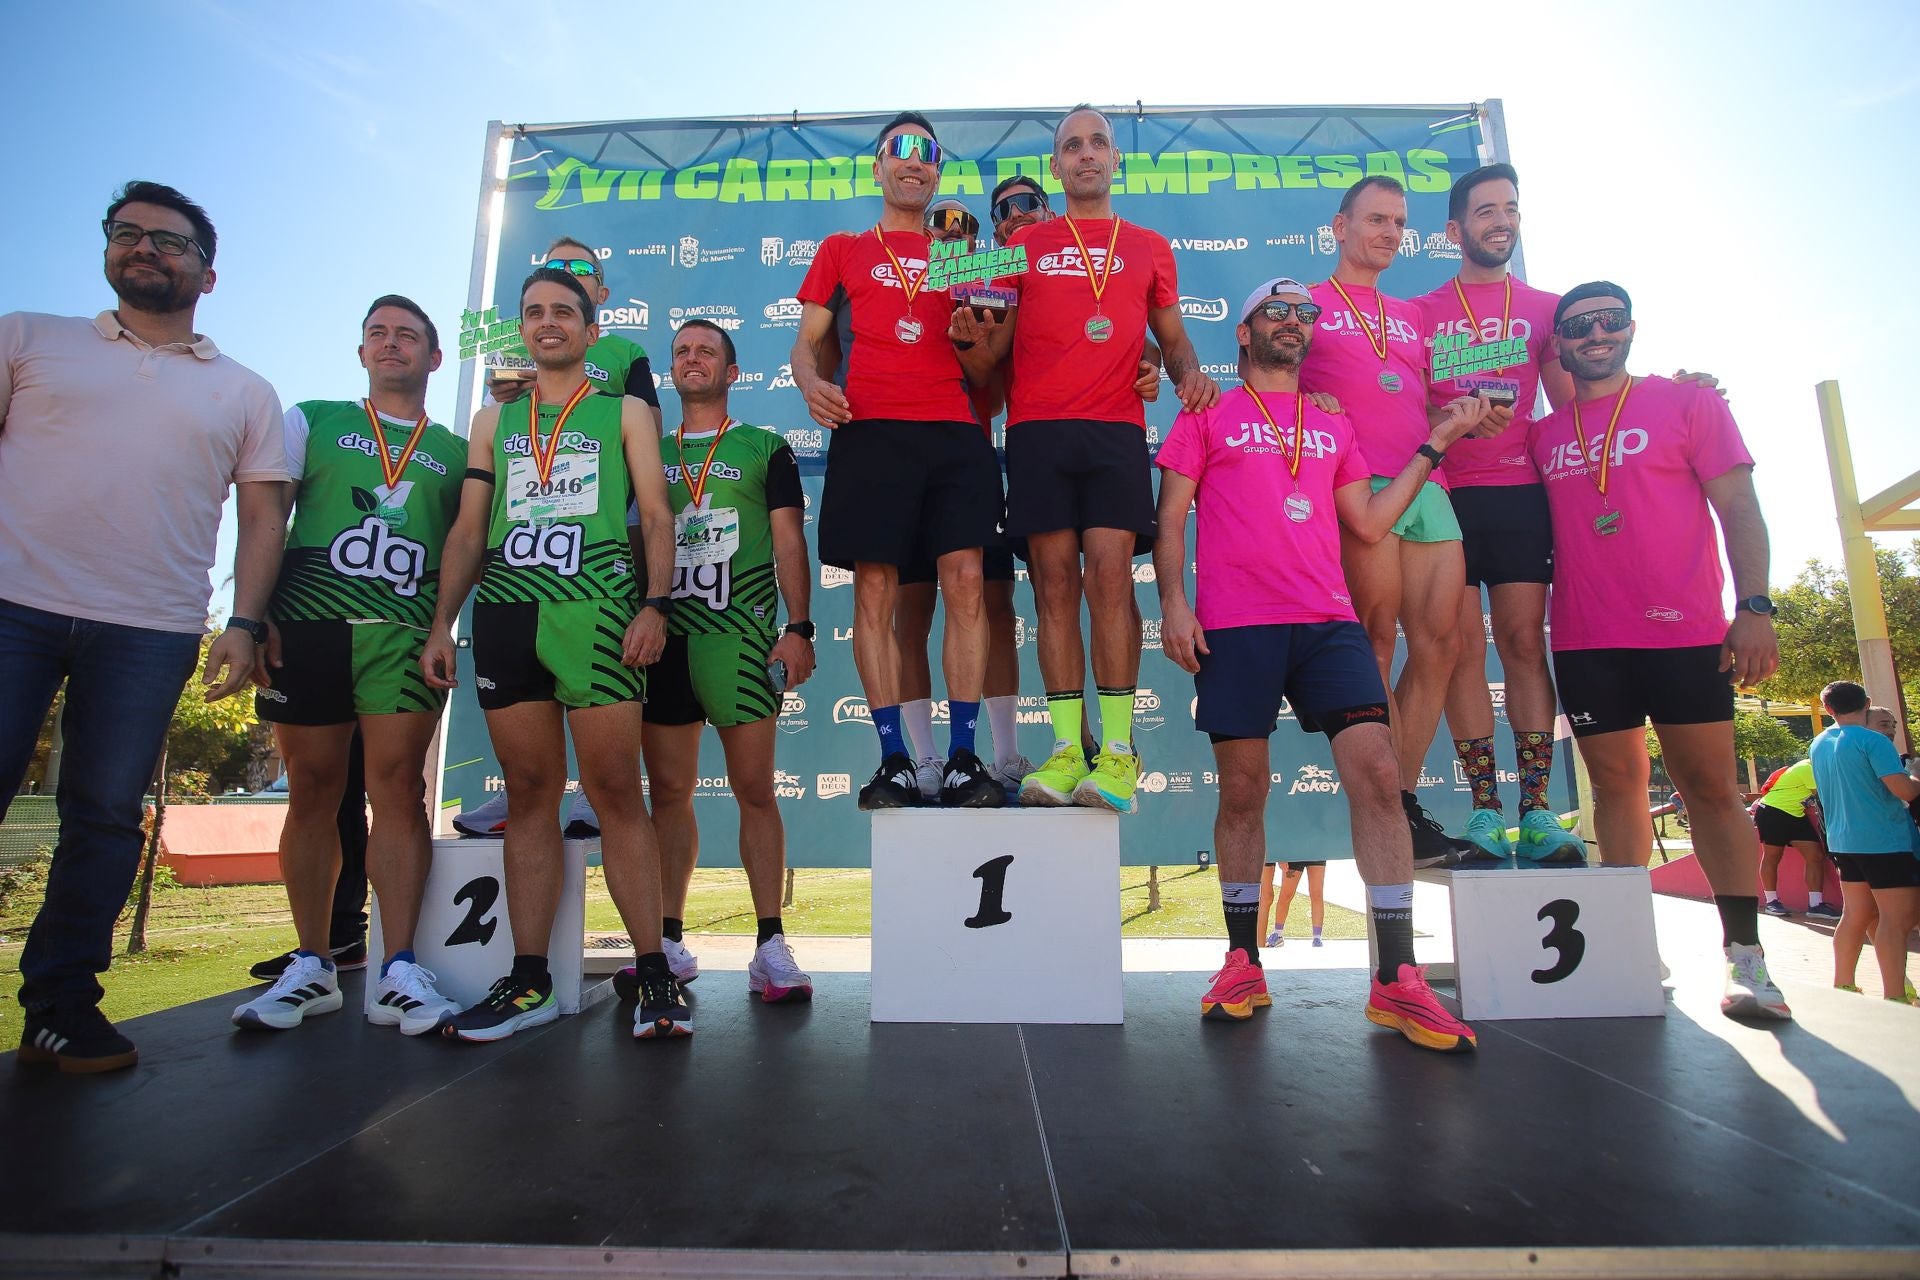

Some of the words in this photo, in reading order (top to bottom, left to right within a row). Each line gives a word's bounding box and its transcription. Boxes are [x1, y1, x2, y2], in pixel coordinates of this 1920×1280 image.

[700, 246, 745, 256] Ayuntamiento
[1180, 237, 1249, 251] VERDAD
[710, 254, 735, 262] Murcia
[928, 245, 1027, 278] CARRERA
[928, 276, 947, 290] DE
[949, 261, 1029, 285] EMPRESAS
[954, 286, 969, 298] LA
[970, 288, 1018, 300] VERDAD
[599, 307, 649, 326] DSM
[685, 307, 705, 317] AMC
[706, 305, 739, 316] GLOBAL
[1180, 303, 1221, 315] VIDAL
[1432, 337, 1527, 370] CARRERA
[485, 355, 497, 366] LA
[500, 356, 537, 369] VERDA
[1433, 369, 1451, 381] DE
[1453, 352, 1529, 376] EMPRESAS
[1458, 379, 1472, 388] LA
[1243, 446, 1270, 454] Grupo
[1549, 471, 1569, 480] Grupo
[526, 477, 583, 497] 2046
[510, 527, 576, 569] dq
[338, 524, 418, 590] dq
[787, 718, 809, 727] familia
[964, 854, 1015, 929] 1
[444, 875, 500, 947] 2
[1530, 898, 1586, 985] 3
